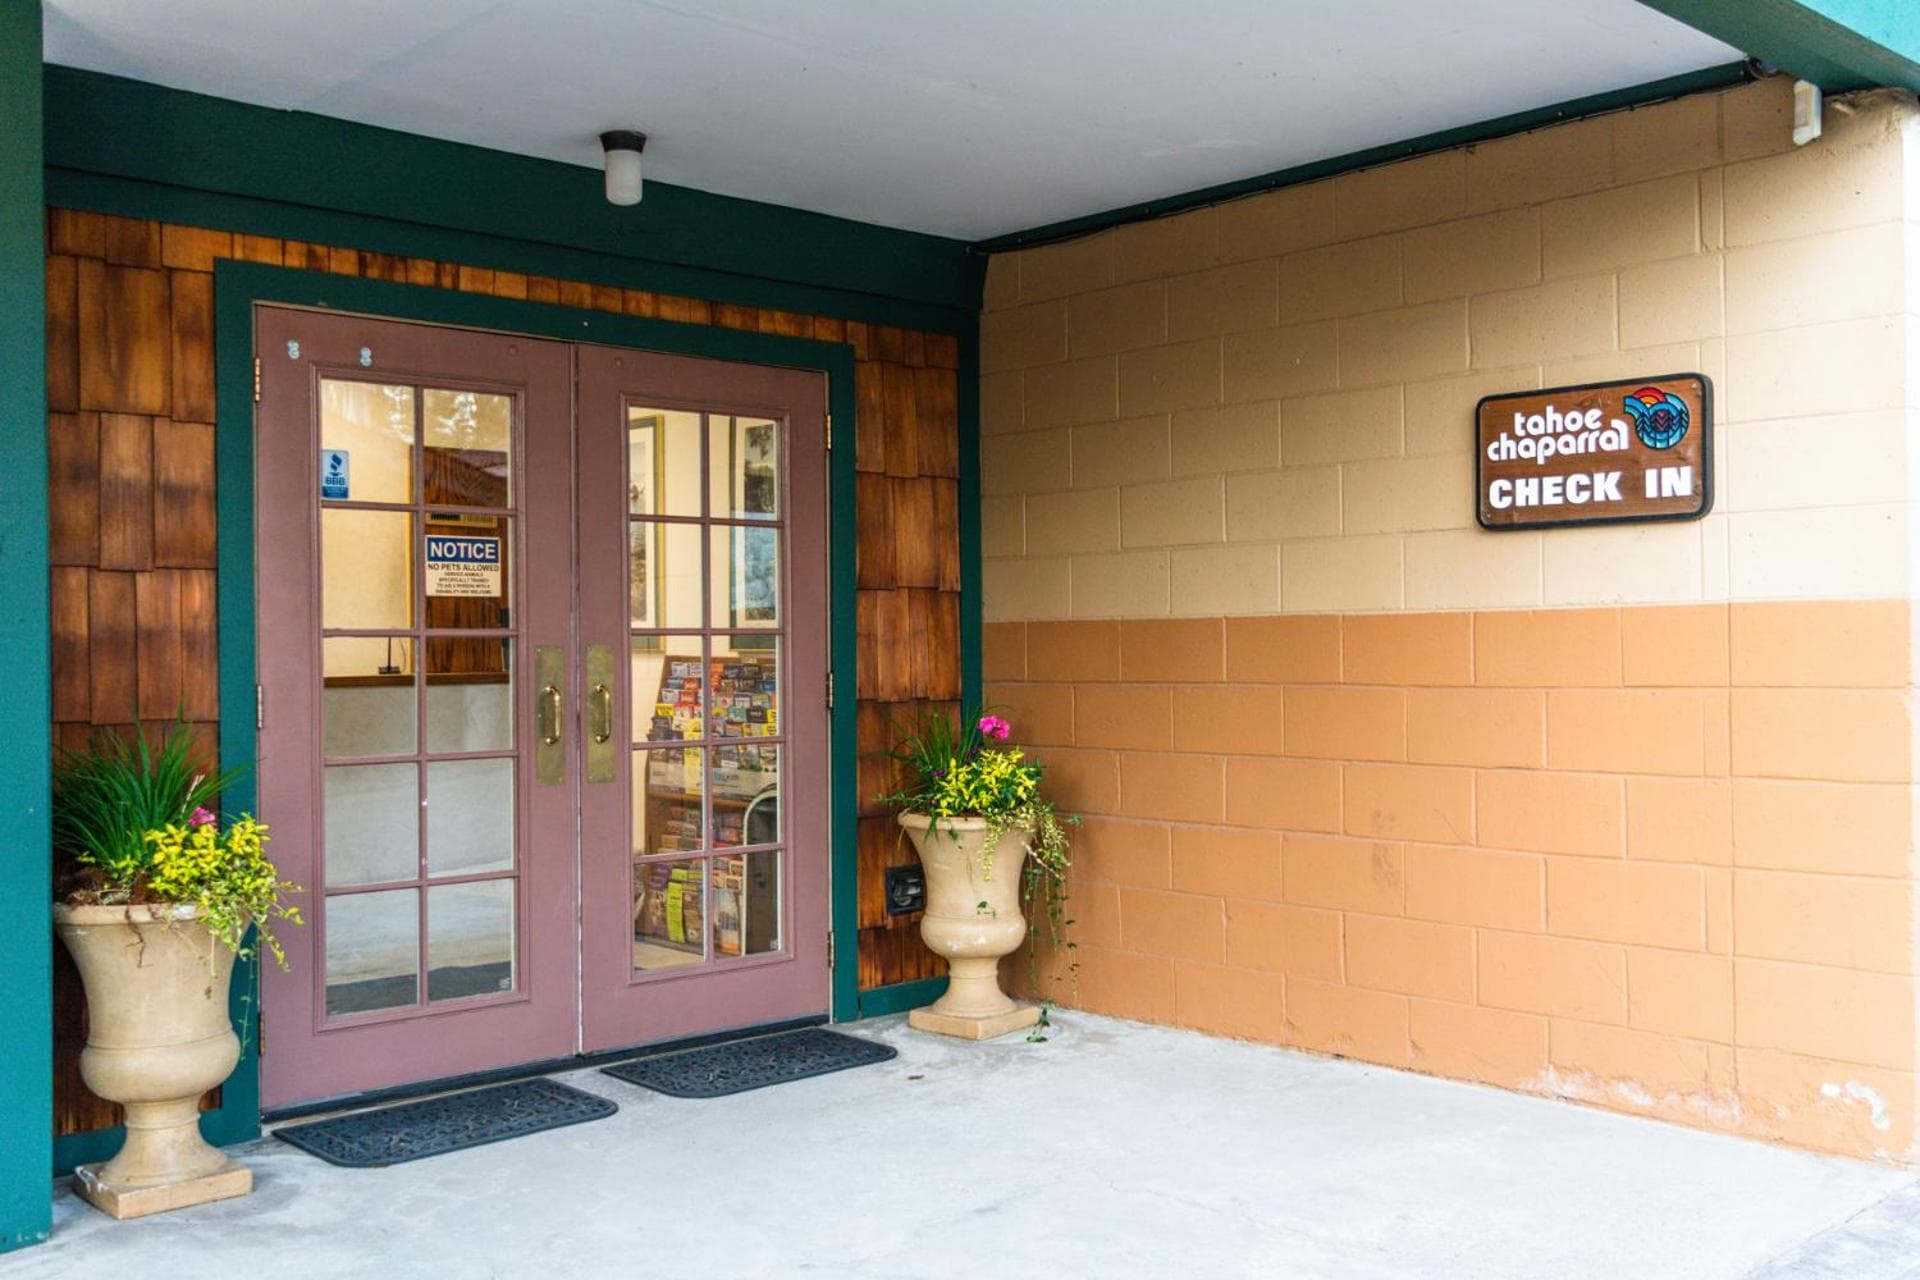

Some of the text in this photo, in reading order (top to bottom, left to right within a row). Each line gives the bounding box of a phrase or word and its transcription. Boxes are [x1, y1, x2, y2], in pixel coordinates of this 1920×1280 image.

[1514, 405, 1603, 437] tahoe
[1487, 419, 1629, 465] chaparral
[325, 476, 346, 485] BBB
[1489, 466, 1693, 509] CHECK IN
[430, 541, 496, 559] NOTICE
[428, 563, 439, 571] NO
[463, 564, 499, 572] ALLOWED
